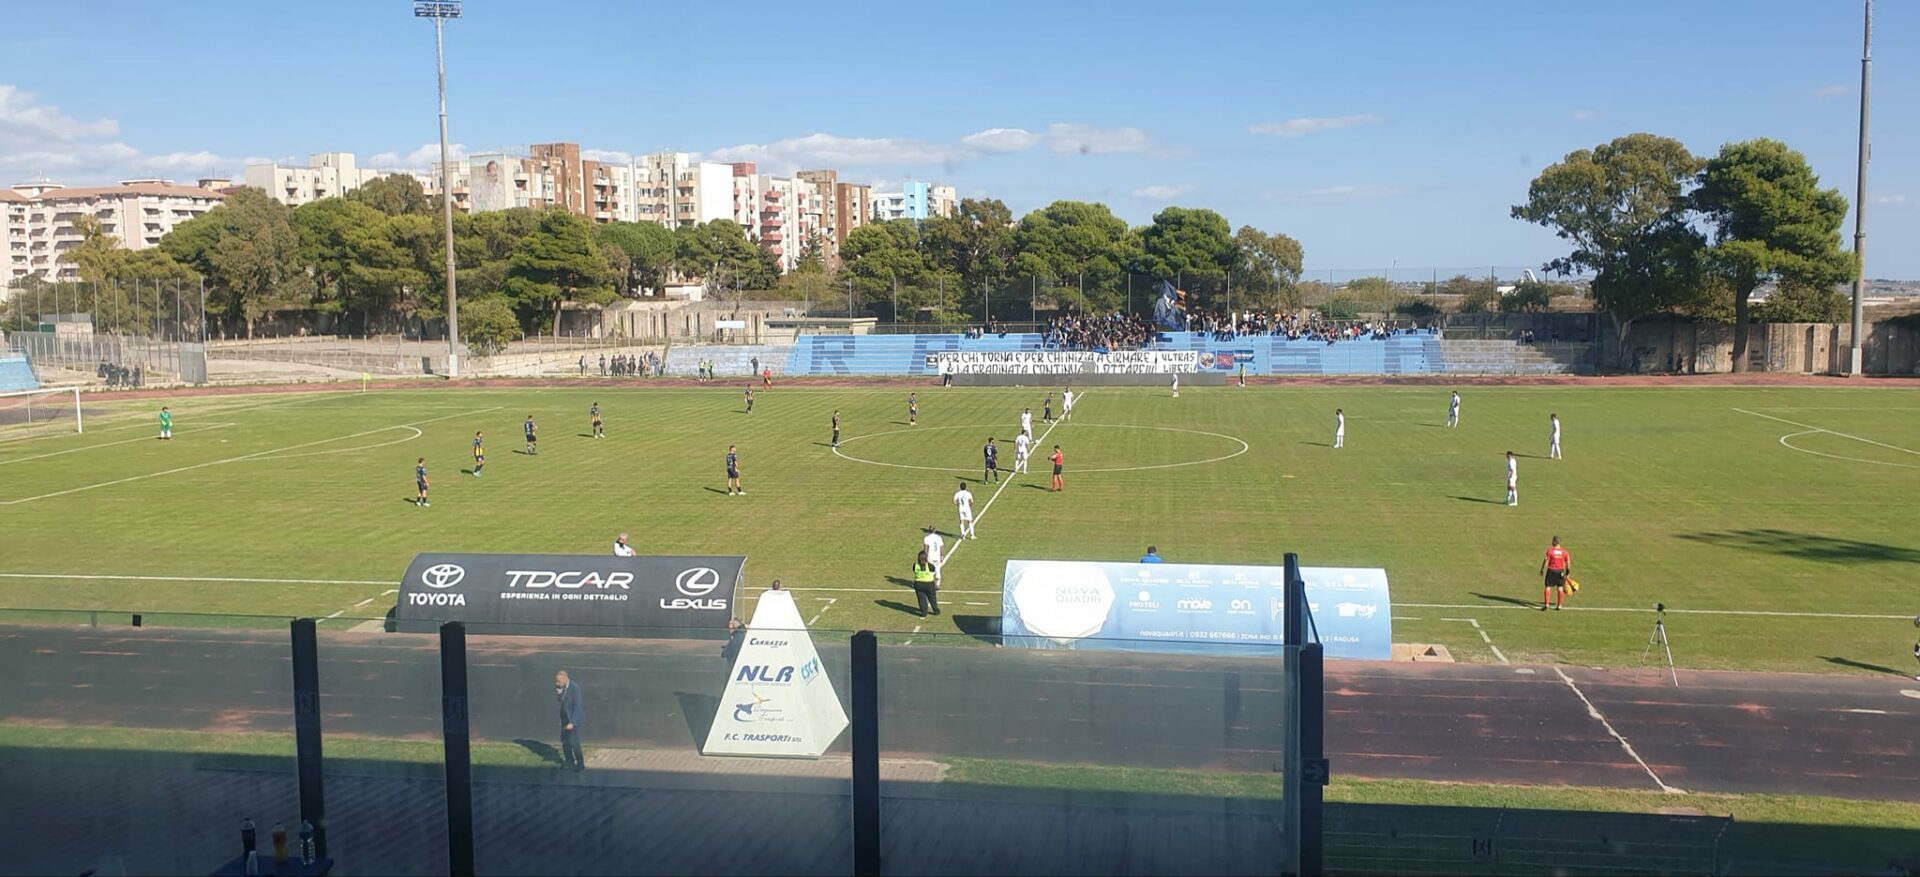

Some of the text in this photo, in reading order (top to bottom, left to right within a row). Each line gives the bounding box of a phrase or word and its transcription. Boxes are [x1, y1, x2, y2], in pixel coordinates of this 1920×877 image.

[505, 570, 634, 589] TDCAR
[1055, 586, 1100, 596] NOVA
[408, 592, 466, 606] TOYOTA
[500, 592, 550, 600] ESPERIENZA
[583, 593, 628, 601] DETTAGLIO
[1055, 595, 1101, 604] QUADRI
[660, 598, 727, 610] LEXUS
[742, 733, 791, 742] TRASPORTI
